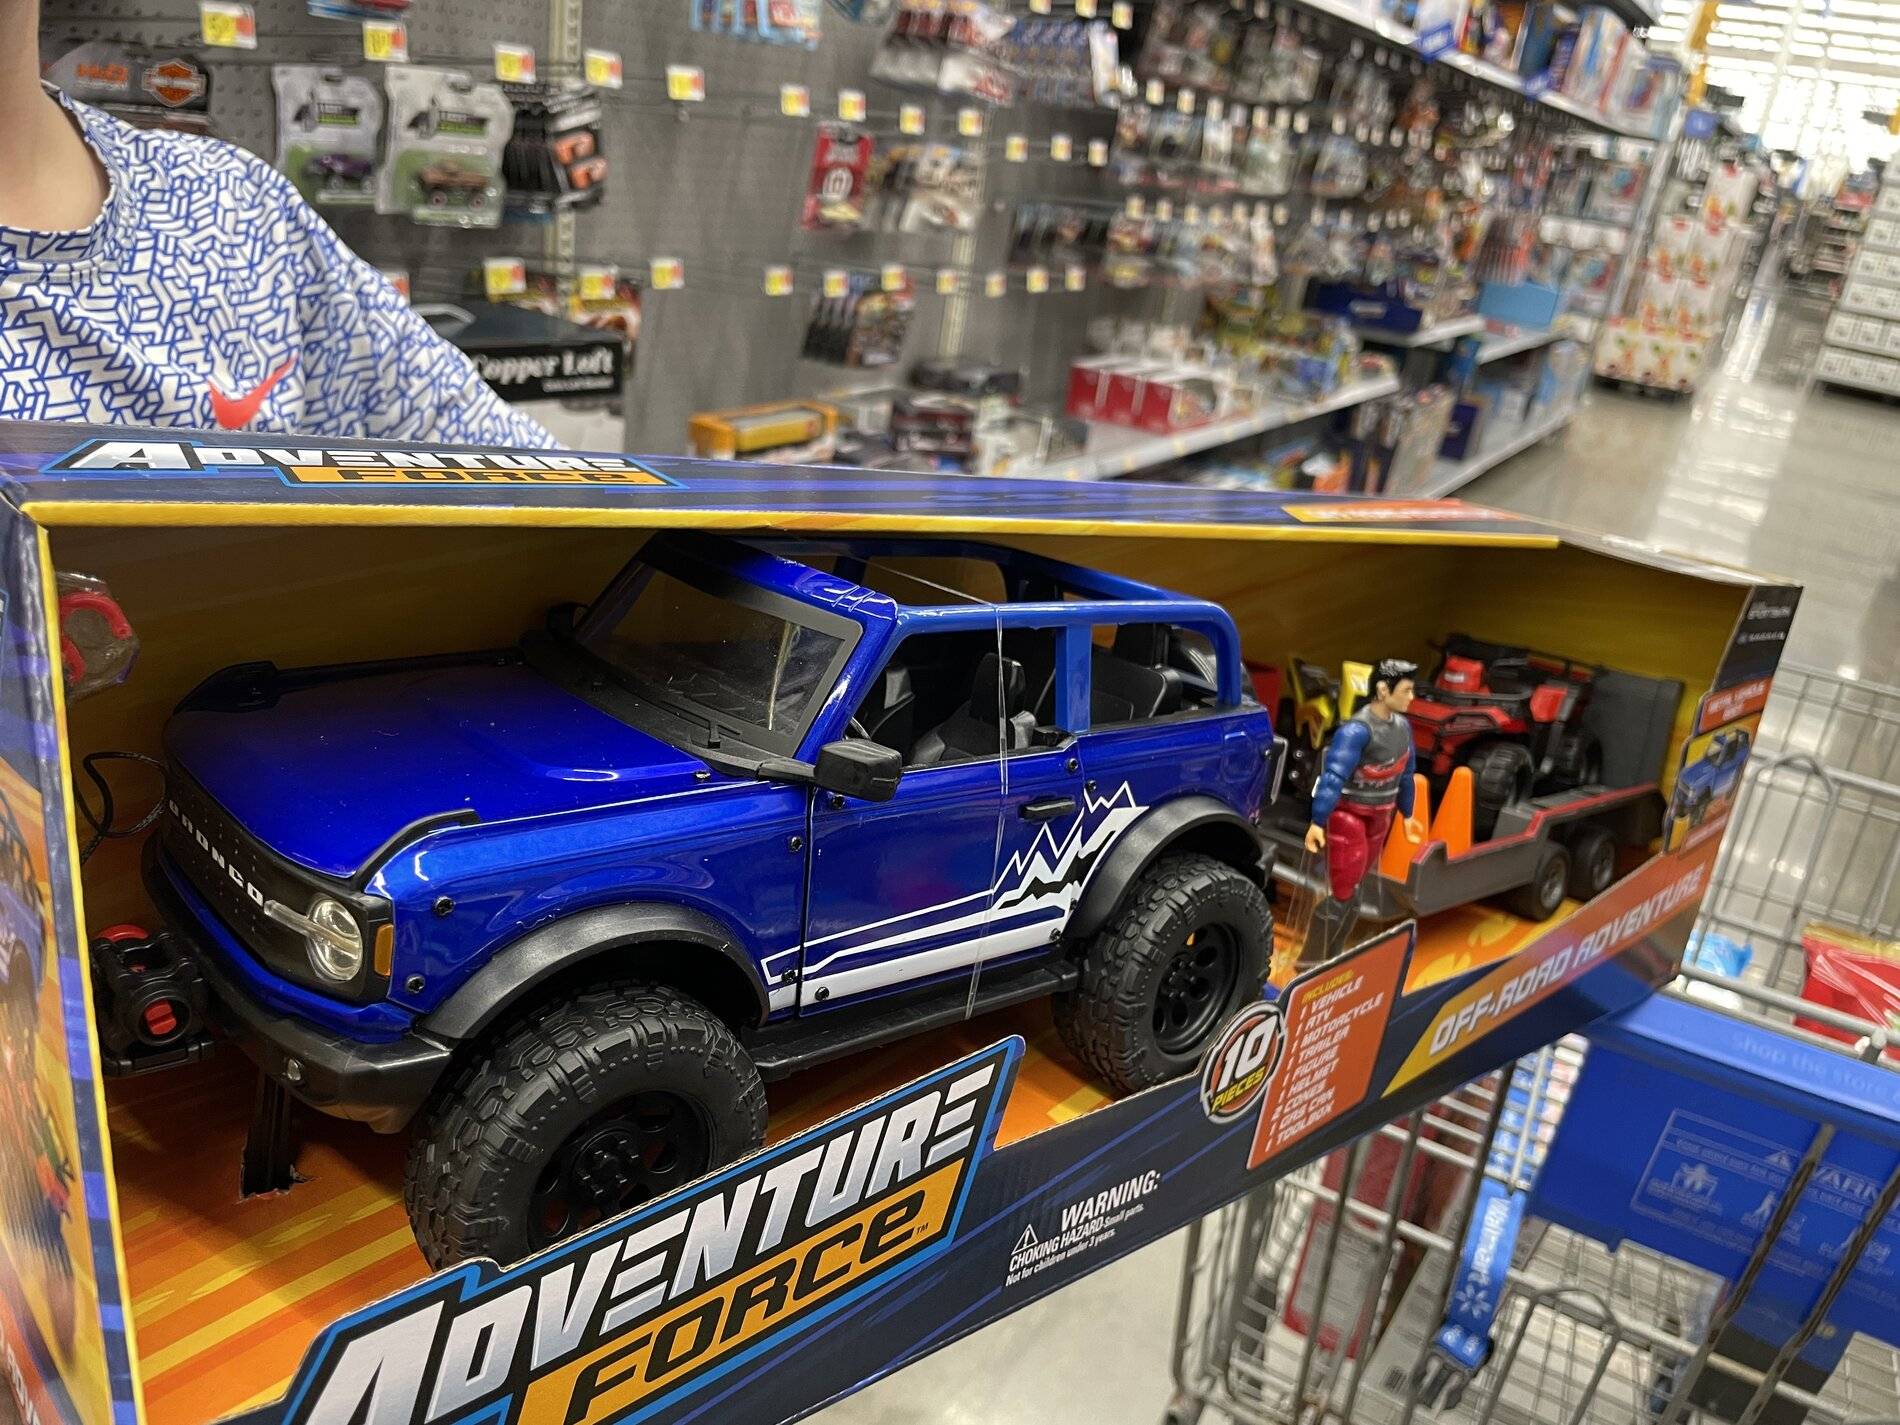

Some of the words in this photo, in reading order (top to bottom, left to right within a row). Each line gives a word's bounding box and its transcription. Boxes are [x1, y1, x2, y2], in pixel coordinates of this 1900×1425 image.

[69, 442, 640, 472] ADVENTURE
[1429, 945, 1573, 1057] OFF-ROAD
[1572, 862, 1706, 969] ADVENTURE
[1300, 1005, 1308, 1021] 1
[1311, 975, 1365, 1014] VEHICLE
[1300, 992, 1385, 1048] MOTORCYCLE
[1305, 1006, 1335, 1031] ATV
[1215, 1014, 1279, 1093] 10
[1292, 1045, 1340, 1082] FIGURE
[1299, 1025, 1351, 1063] TRAILER
[1211, 1065, 1266, 1113] PIECES
[1283, 1078, 1327, 1113] CONES
[1287, 1057, 1341, 1098] HELMET
[1276, 1098, 1336, 1145] TOOLBOX
[1061, 1169, 1161, 1232] WARNING:
[304, 1063, 996, 1425] ADVENTURE
[1005, 1271, 1021, 1287] Not
[1021, 1265, 1033, 1280] for
[1034, 1252, 1066, 1273] children
[1066, 1241, 1089, 1259] under
[1009, 1236, 1060, 1272] CHOKING
